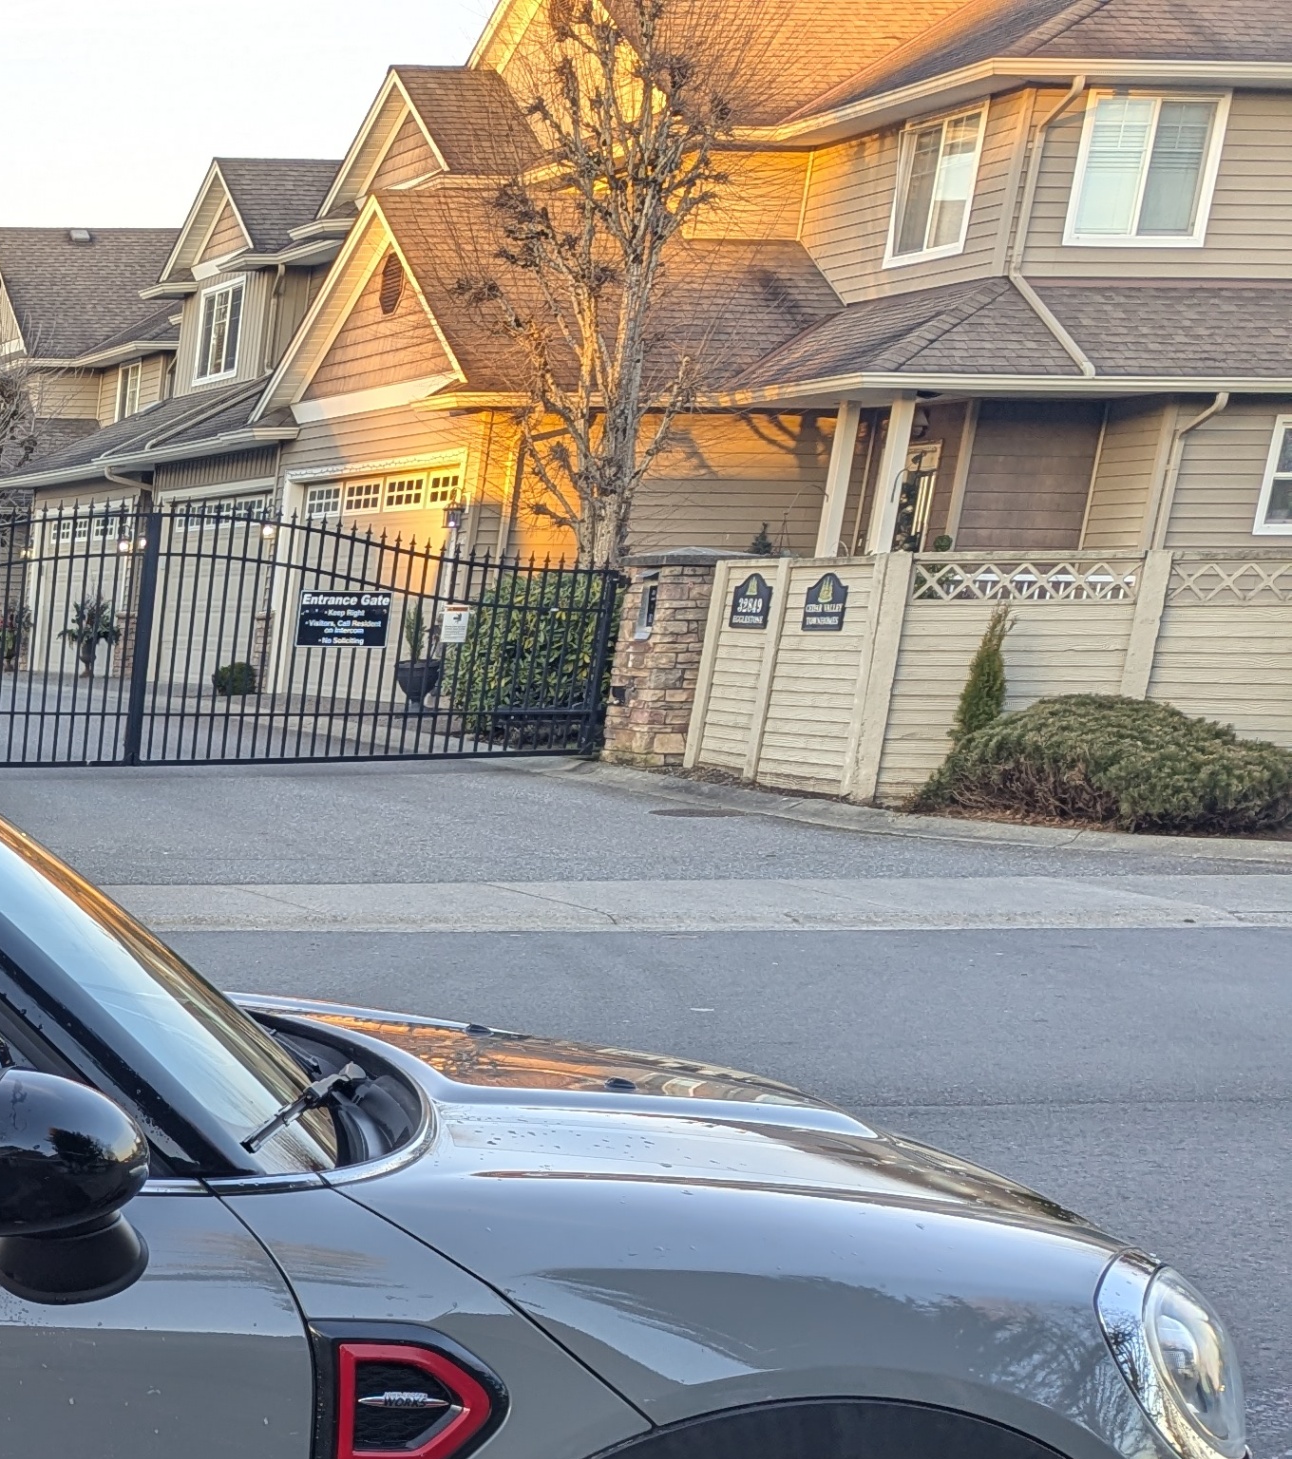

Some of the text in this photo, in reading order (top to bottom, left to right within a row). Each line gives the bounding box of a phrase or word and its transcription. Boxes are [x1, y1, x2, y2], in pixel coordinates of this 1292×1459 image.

[302, 594, 390, 606] Entrance Gate
[736, 598, 763, 614] 32849
[806, 603, 844, 612] CEDAR VALLEY
[346, 609, 365, 618] Right
[308, 620, 336, 628] Visitors,
[332, 637, 364, 645] Soliciting
[384, 1396, 426, 1408] WORKS
